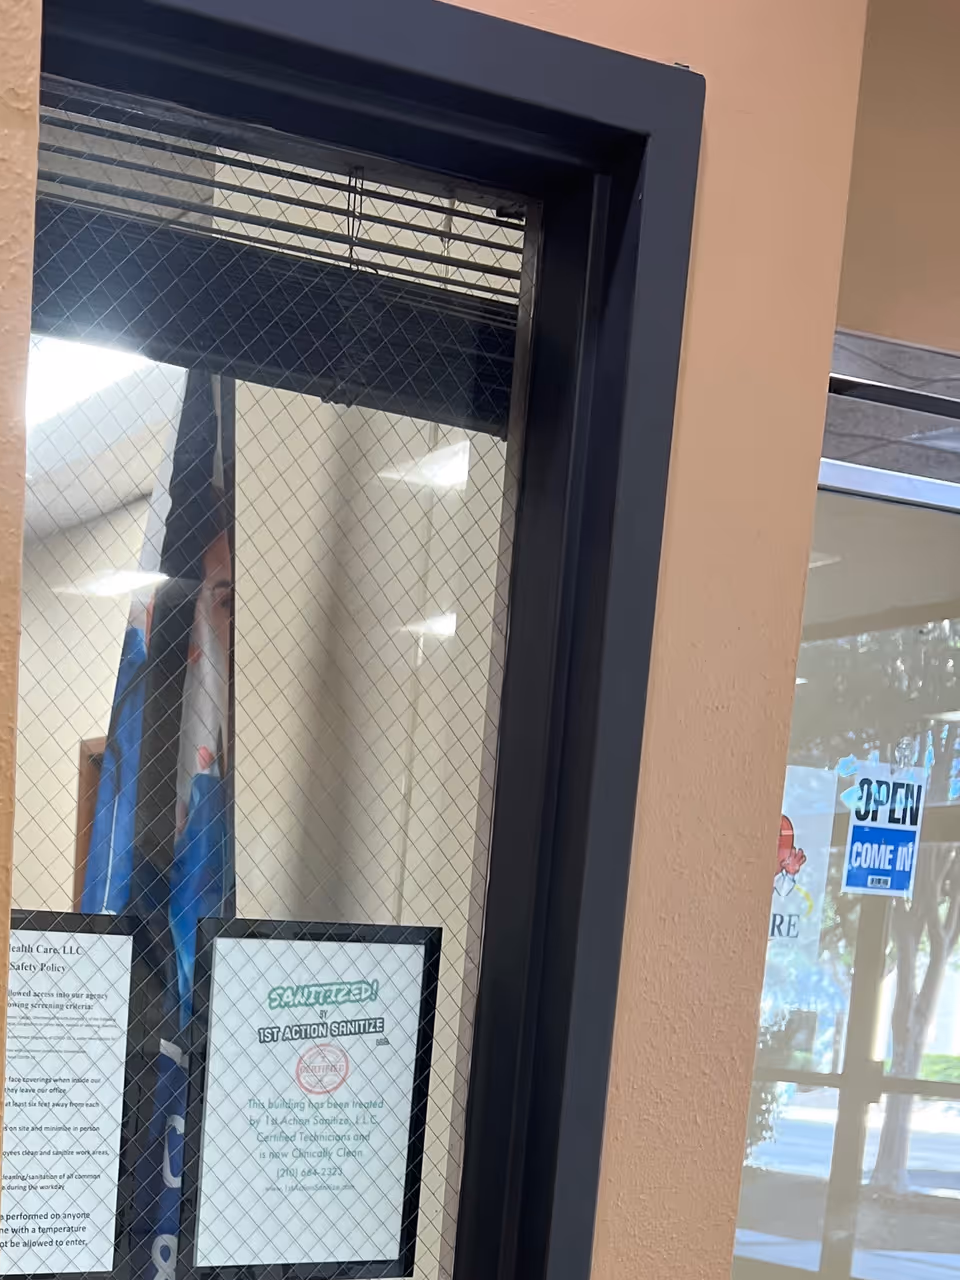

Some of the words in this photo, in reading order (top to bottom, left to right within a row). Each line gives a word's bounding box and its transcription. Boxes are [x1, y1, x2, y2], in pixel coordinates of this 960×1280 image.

[855, 778, 922, 826] OPEN
[850, 841, 894, 870] COME
[895, 844, 914, 871] IN
[9, 943, 33, 953] ealth
[63, 946, 82, 956] LLC
[10, 961, 37, 973] Safety
[41, 963, 65, 974] Policy
[33, 991, 54, 999] access
[86, 992, 108, 1001] agency
[268, 979, 379, 1010] SANITIZED!
[31, 1001, 64, 1011] screening
[258, 1027, 281, 1044] 1ST
[282, 1022, 328, 1042] ACTION
[329, 1017, 385, 1038] SANITIZE
[86, 1100, 100, 1108] each
[248, 1098, 265, 1109] This
[268, 1097, 305, 1112] building
[327, 1097, 348, 1109] been
[351, 1098, 384, 1109] treated
[250, 1115, 260, 1129] by
[282, 1115, 311, 1126] Action
[257, 1130, 296, 1142] Certified
[300, 1130, 350, 1141] Technicians
[353, 1129, 370, 1141] and
[259, 1149, 266, 1159] is
[269, 1150, 289, 1160] now
[291, 1147, 333, 1161] Clinically
[336, 1146, 363, 1158] Clean
[6, 1211, 49, 1222] performed
[50, 1212, 61, 1220] on
[63, 1211, 90, 1222] anyone
[11, 1225, 29, 1234] with
[38, 1225, 86, 1235] temperature
[10, 1239, 21, 1247] be
[22, 1239, 54, 1248] allowed
[55, 1239, 64, 1247] to
